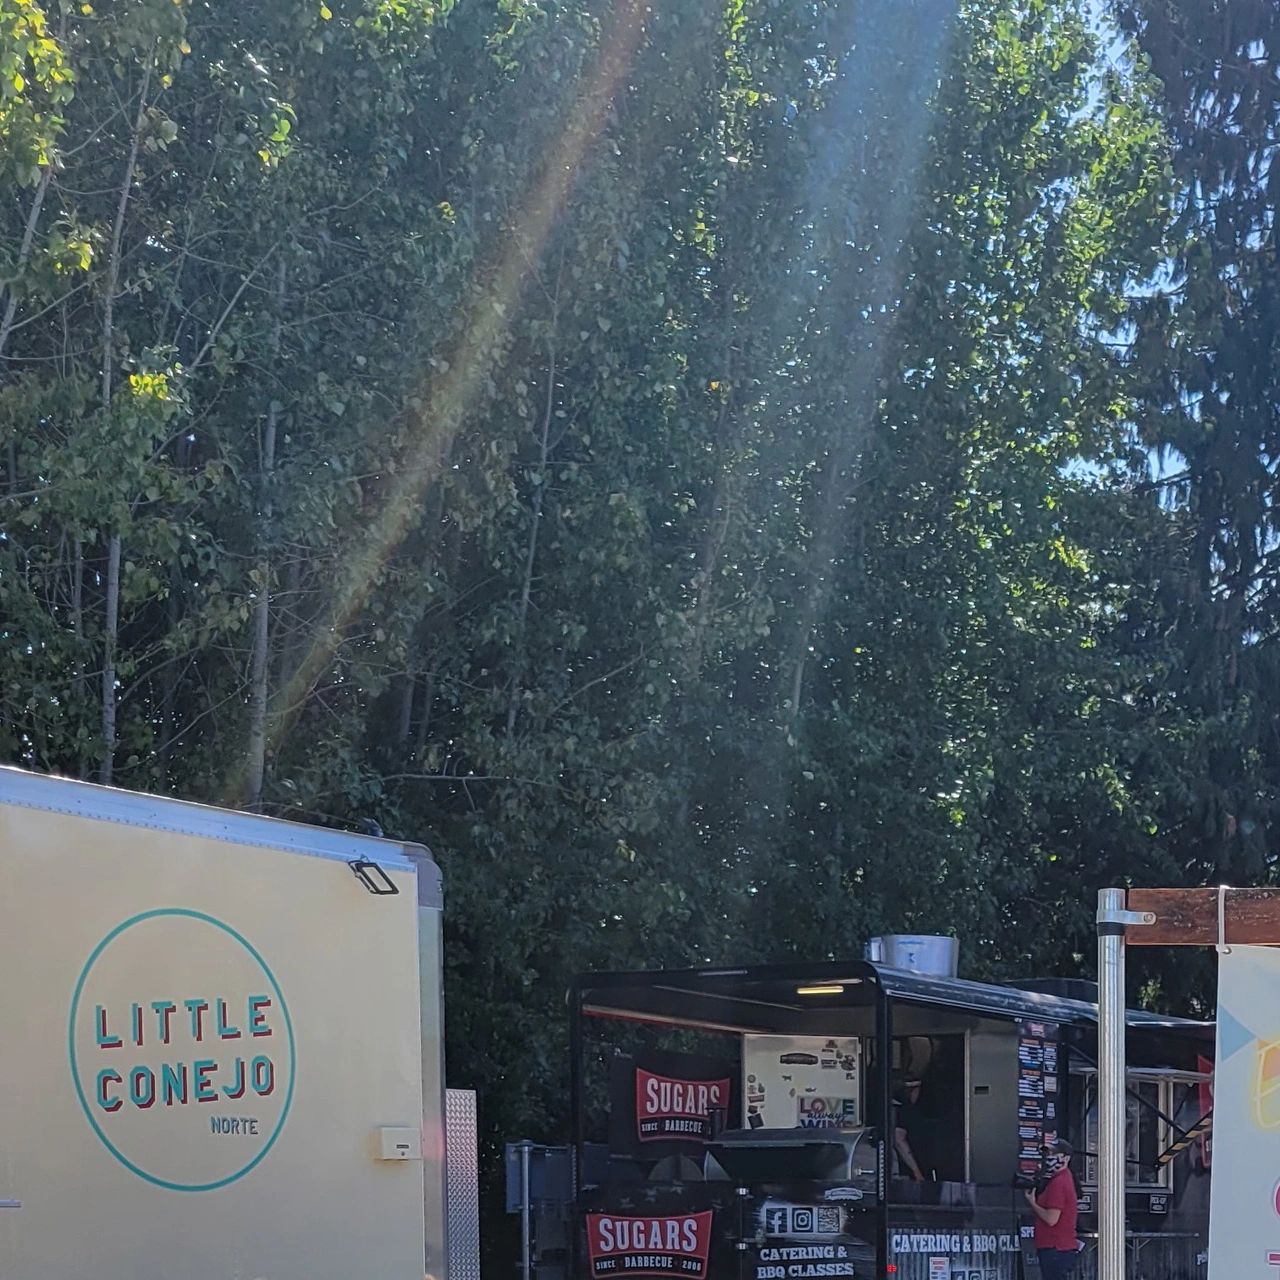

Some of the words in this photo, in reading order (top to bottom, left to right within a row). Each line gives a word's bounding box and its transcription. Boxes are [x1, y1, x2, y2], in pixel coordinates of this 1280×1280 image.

[95, 995, 273, 1049] LITTLE
[96, 1055, 274, 1112] CONEJO
[646, 1077, 720, 1115] SUGARS
[800, 1097, 855, 1115] LOVE
[210, 1116, 259, 1135] NORTE
[665, 1119, 703, 1133] BARBECUE
[599, 1218, 698, 1252] SUGARS
[892, 1234, 960, 1252] CATERING
[962, 1235, 971, 1252] &
[973, 1234, 997, 1254] BBQ
[625, 1256, 673, 1268] BARBECUE
[760, 1246, 834, 1261] CATERING
[837, 1245, 848, 1258] &
[757, 1266, 785, 1279] BBQ
[788, 1263, 854, 1277] CLASSES
